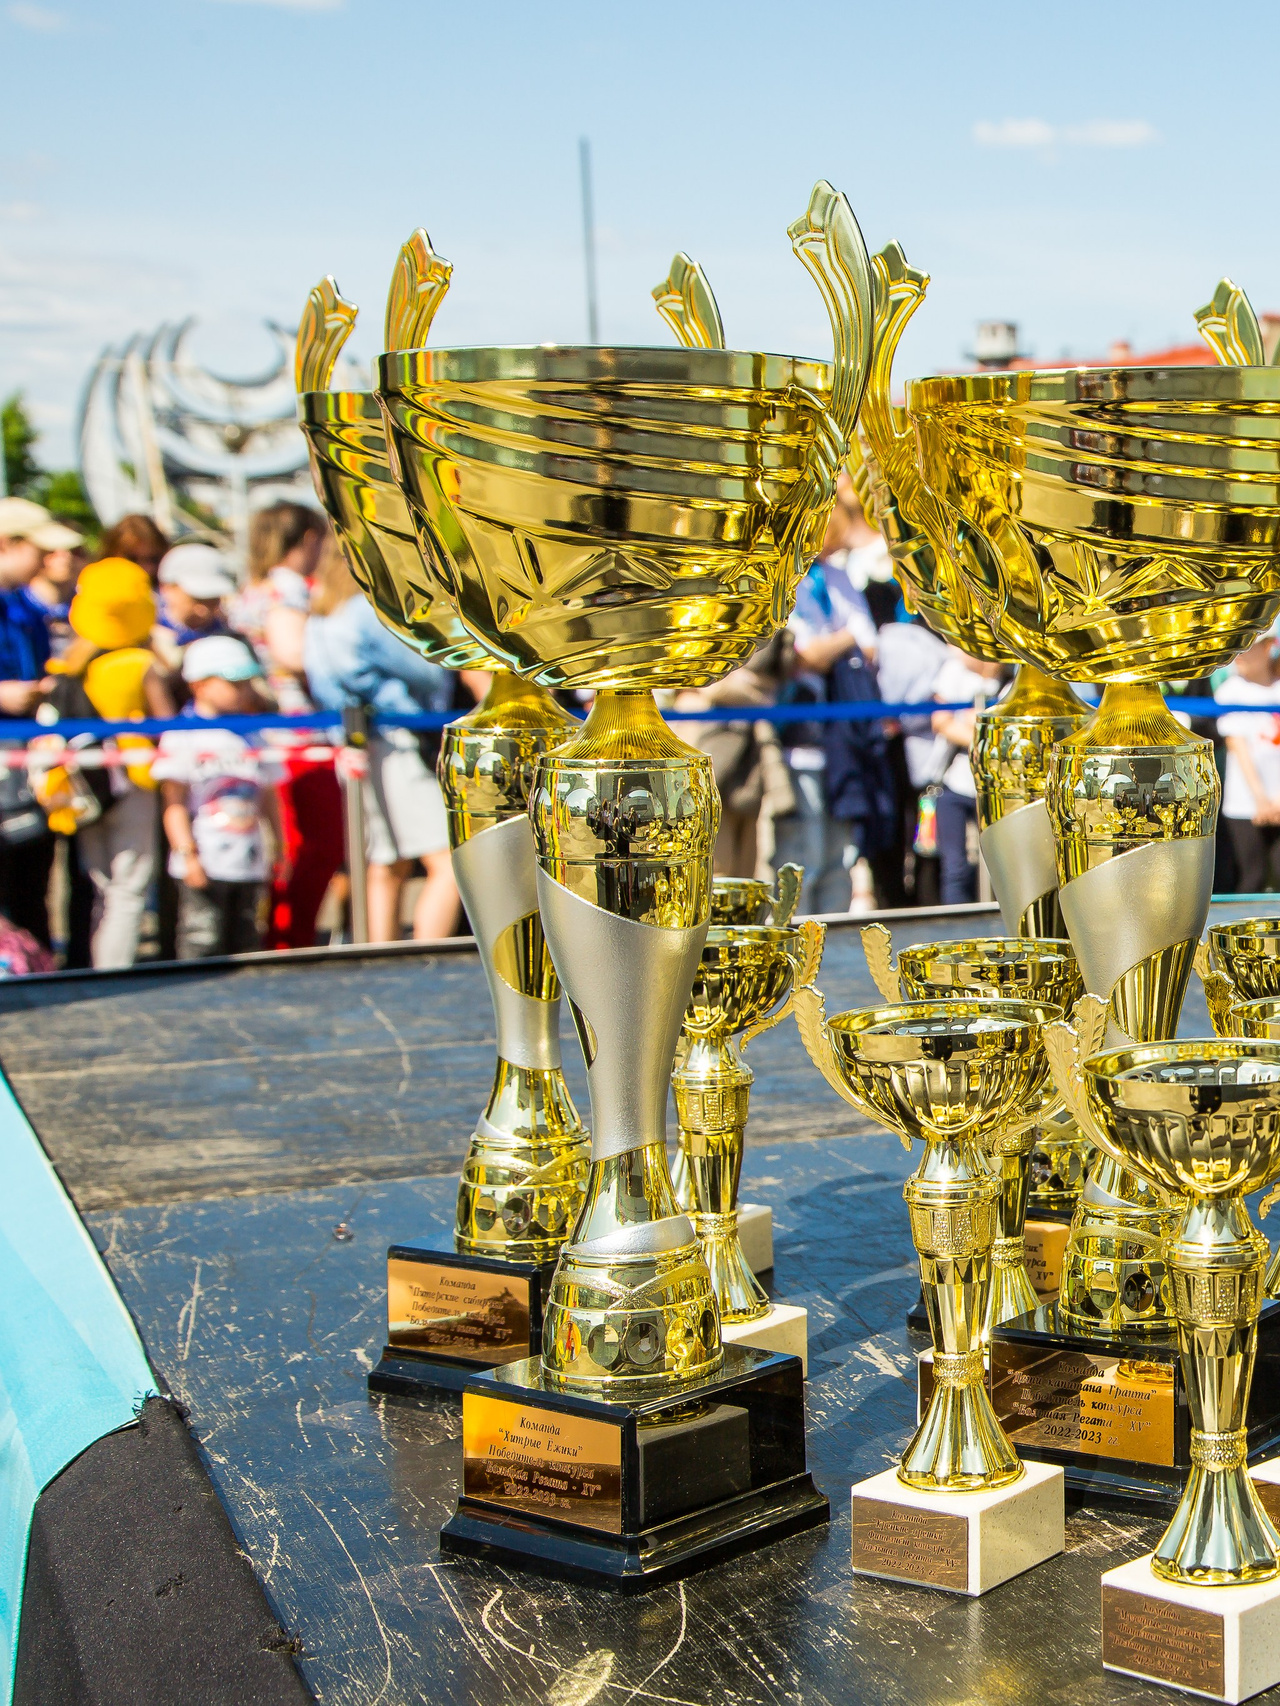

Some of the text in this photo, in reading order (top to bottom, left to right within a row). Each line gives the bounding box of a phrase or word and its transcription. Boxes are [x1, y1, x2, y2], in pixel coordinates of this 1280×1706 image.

[439, 1276, 476, 1291] Команда
[412, 1301, 461, 1318] Победитель
[1058, 1360, 1105, 1378] Команда
[1048, 1378, 1102, 1394] капитана
[1108, 1383, 1157, 1401] Гранта”
[1021, 1388, 1143, 1417] Победитель конкурса
[520, 1416, 561, 1436] Команда
[1012, 1401, 1067, 1421] “Большая
[1072, 1412, 1113, 1428] Регата
[1129, 1420, 1151, 1432] XV”
[498, 1427, 583, 1457] “Хитрые Ёжики”
[1044, 1424, 1102, 1445] 2022-2023
[489, 1444, 595, 1480] Победитель конкурса
[532, 1470, 569, 1491] Регата
[504, 1481, 557, 1507] 2022-2023
[891, 1509, 928, 1525] Команда
[868, 1530, 951, 1556] Финалист конкурса
[902, 1549, 933, 1564] Регата
[1143, 1602, 1181, 1620] Команда
